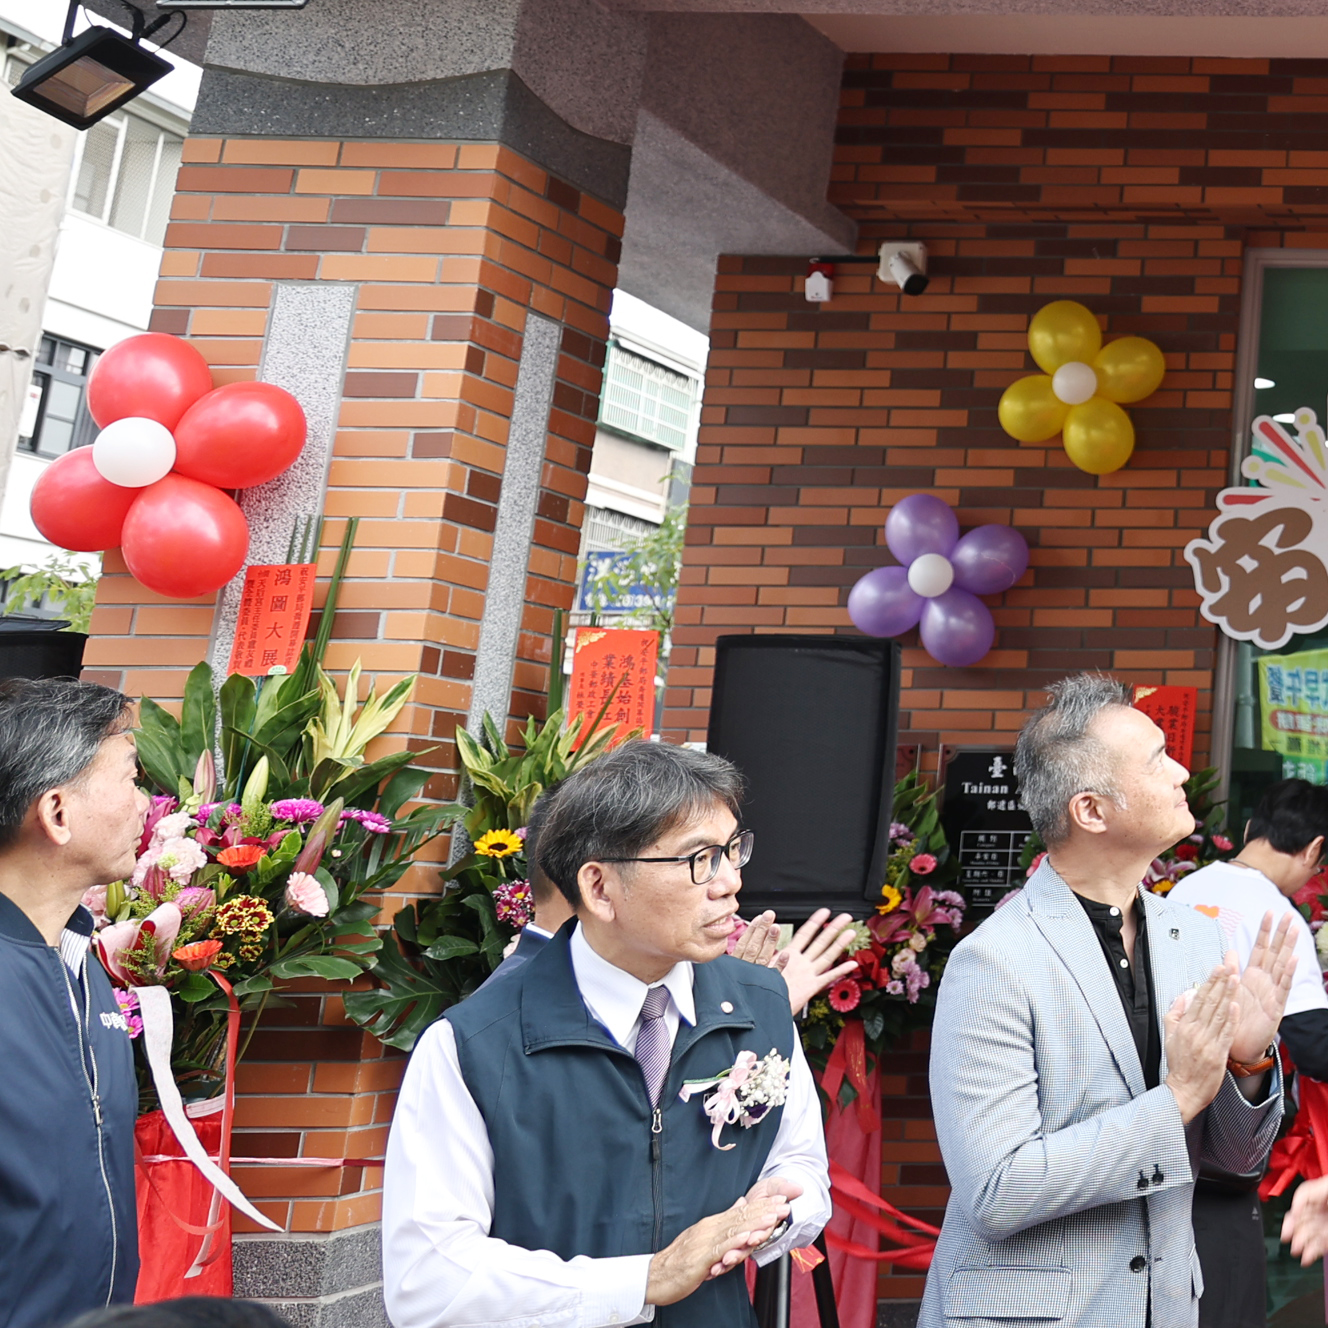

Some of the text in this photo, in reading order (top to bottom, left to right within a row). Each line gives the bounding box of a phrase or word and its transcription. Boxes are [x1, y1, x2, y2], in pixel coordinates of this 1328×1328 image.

[261, 568, 292, 667] 鴻圖大展
[961, 782, 1009, 795] Tainan
